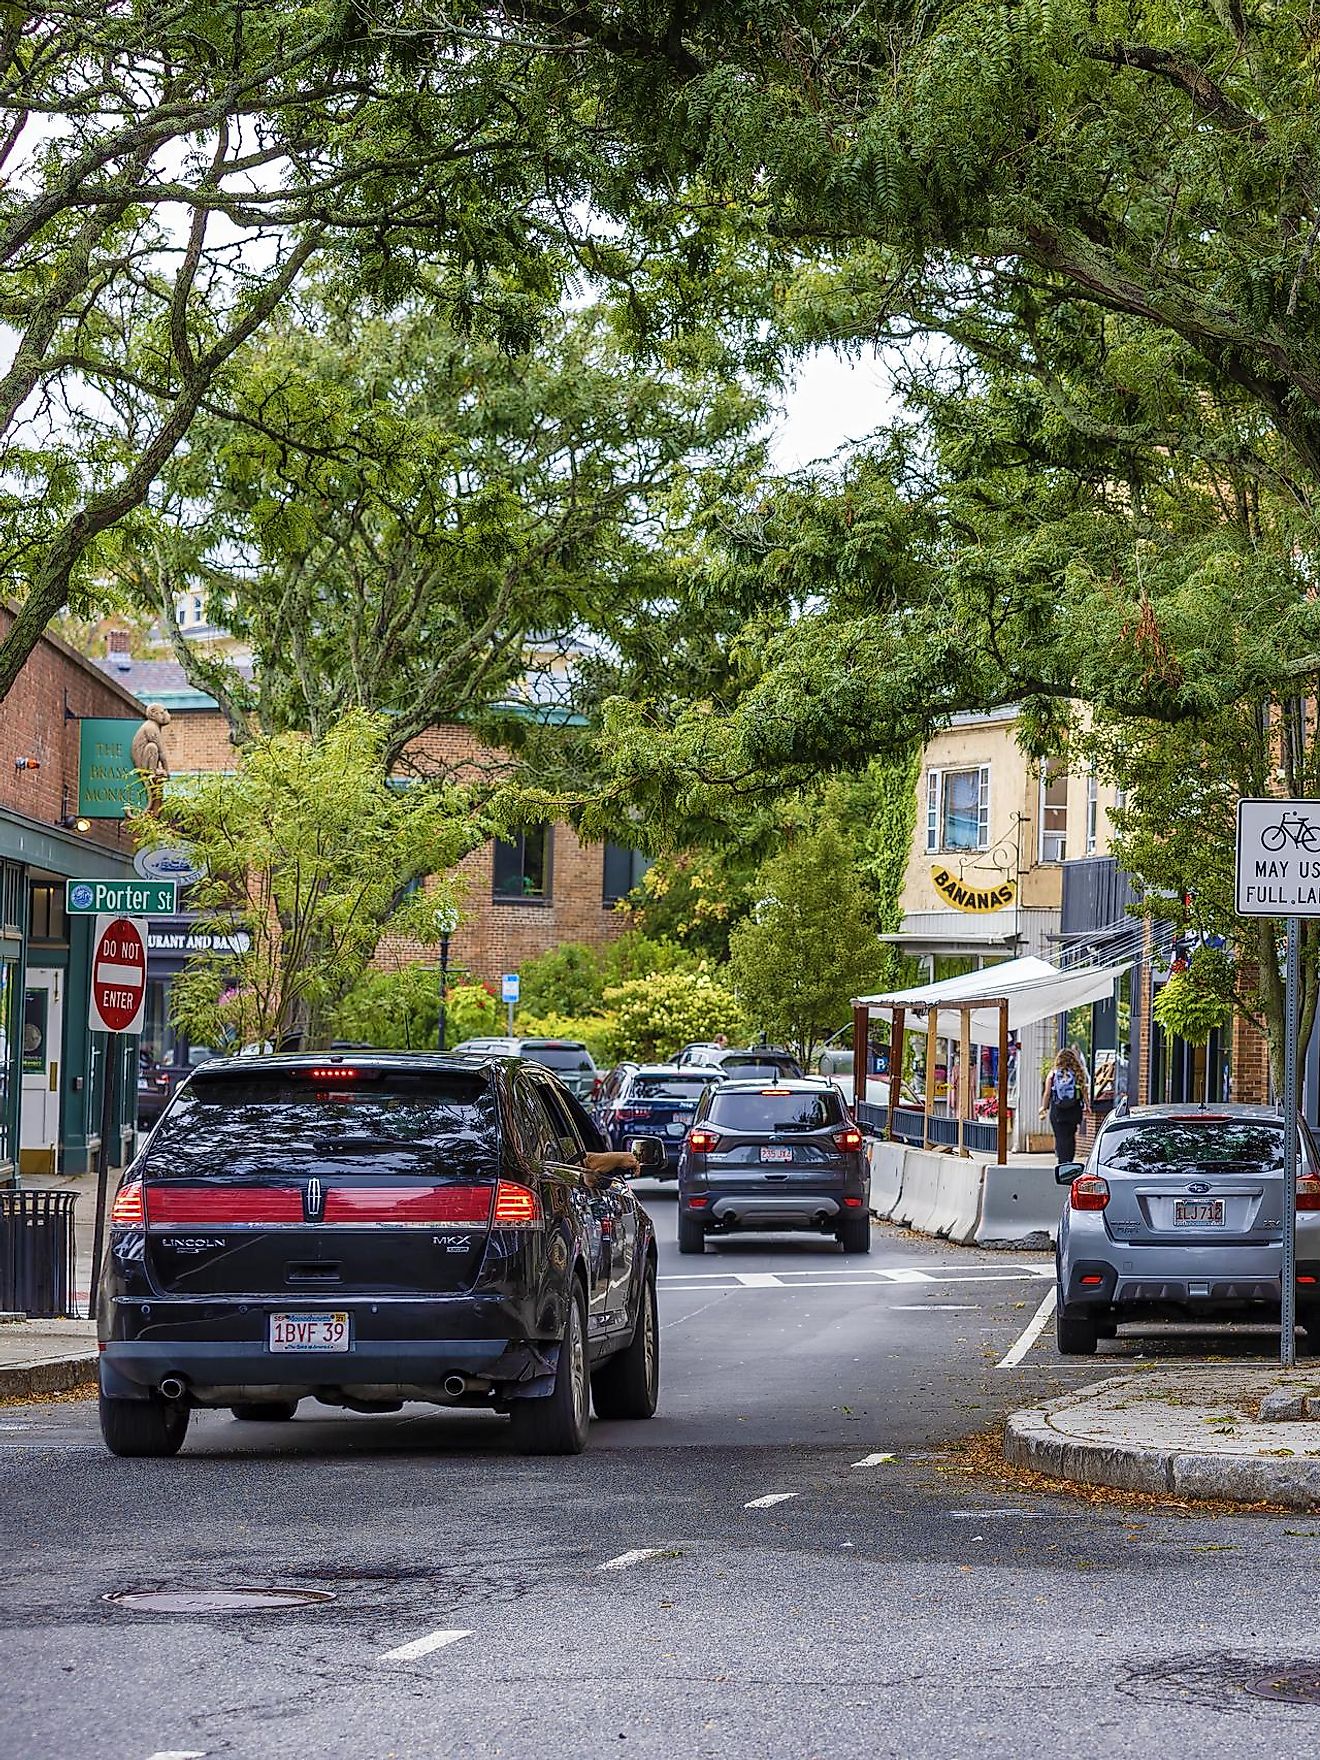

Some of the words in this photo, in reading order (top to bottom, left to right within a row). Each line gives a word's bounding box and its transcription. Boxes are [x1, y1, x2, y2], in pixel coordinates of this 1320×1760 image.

[96, 742, 123, 758] THE
[1255, 860, 1289, 878] MAY
[95, 884, 151, 909] Porter
[157, 891, 173, 911] St
[933, 870, 1013, 909] BANANAS
[1246, 886, 1288, 904] FULL
[102, 939, 117, 958] DO
[121, 942, 141, 961] NOT
[148, 934, 186, 950] URANT
[186, 934, 213, 950] AND
[102, 990, 134, 1010] ENTER
[162, 1239, 226, 1247] LINCOLN
[432, 1235, 472, 1245] MKX
[274, 1322, 318, 1343] 1BVF
[322, 1322, 344, 1343] 39
